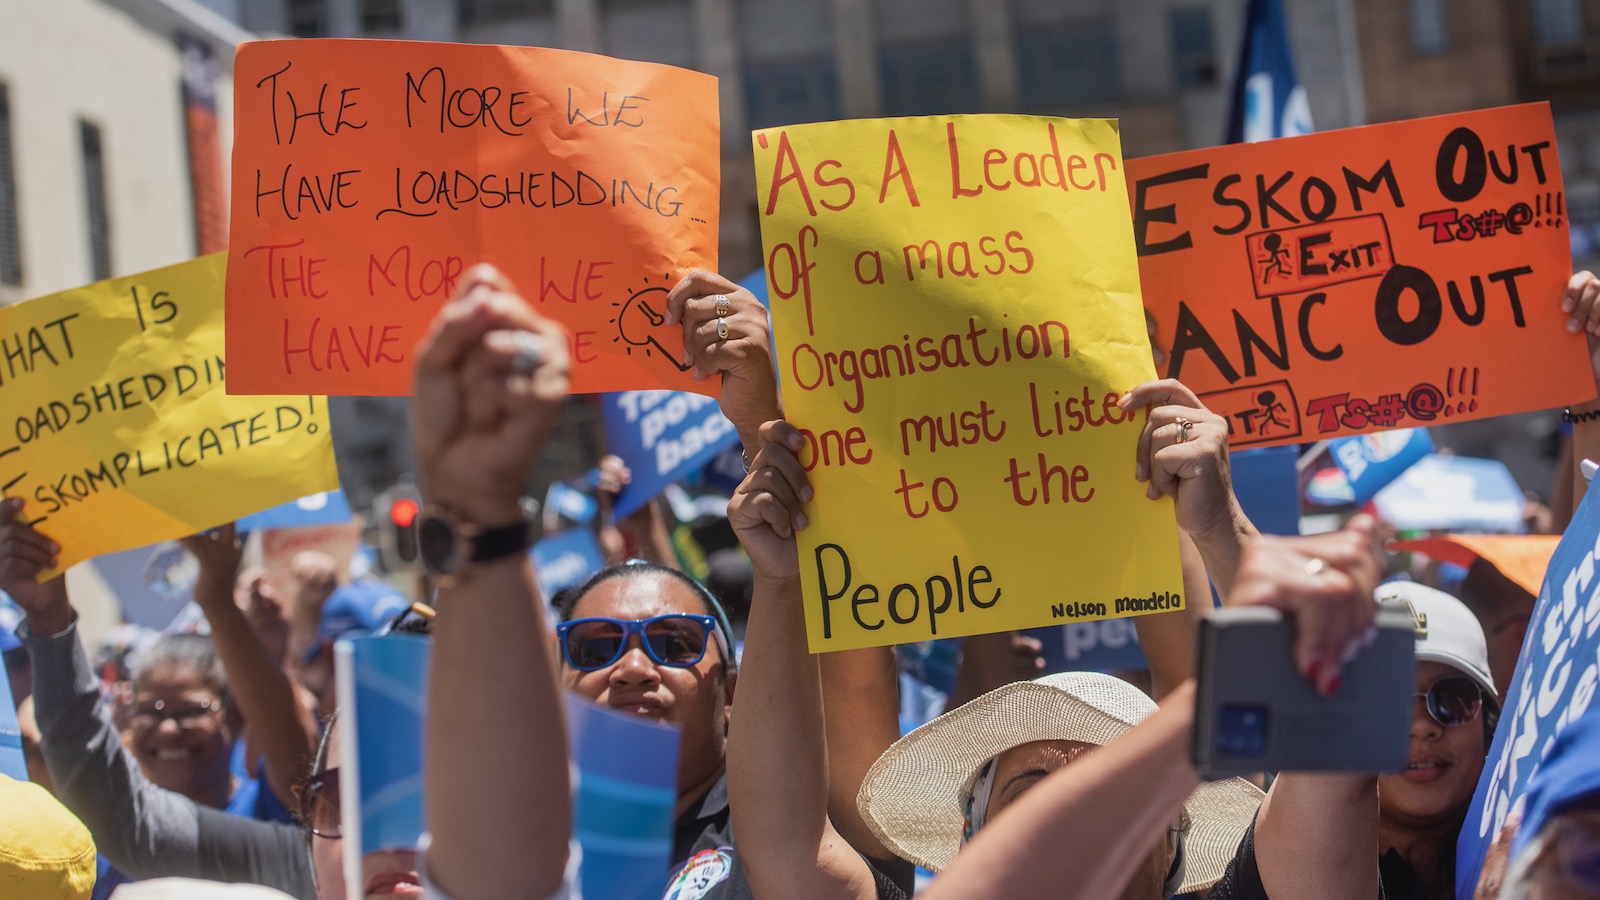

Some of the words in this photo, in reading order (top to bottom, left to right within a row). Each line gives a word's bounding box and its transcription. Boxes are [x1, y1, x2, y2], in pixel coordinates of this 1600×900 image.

[257, 62, 367, 144] THE
[406, 67, 533, 136] MORE
[567, 87, 647, 127] WE
[256, 164, 361, 219] HAVE
[879, 130, 920, 207] A
[946, 122, 1117, 199] Leader
[1134, 160, 1405, 257] ESKOM
[1435, 127, 1550, 202] OUT
[243, 239, 328, 300] THE
[368, 245, 464, 301] MOR
[540, 256, 614, 303] WE
[854, 250, 885, 285] a
[903, 230, 1035, 282] mass
[1298, 232, 1382, 278] EXIT
[0, 313, 80, 387] HAT
[284, 318, 405, 373] HAVE
[1167, 292, 1345, 385] ANC
[1375, 264, 1533, 346] OUT
[792, 314, 1070, 413] Organisation
[0, 355, 225, 458] OADSHEDDIN
[901, 400, 1007, 456] must
[1227, 408, 1260, 437] IT
[894, 469, 959, 519] to
[1003, 453, 1095, 506] the
[814, 543, 1001, 639] People
[1051, 601, 1106, 618] Nelson
[1063, 616, 1140, 661] pe
